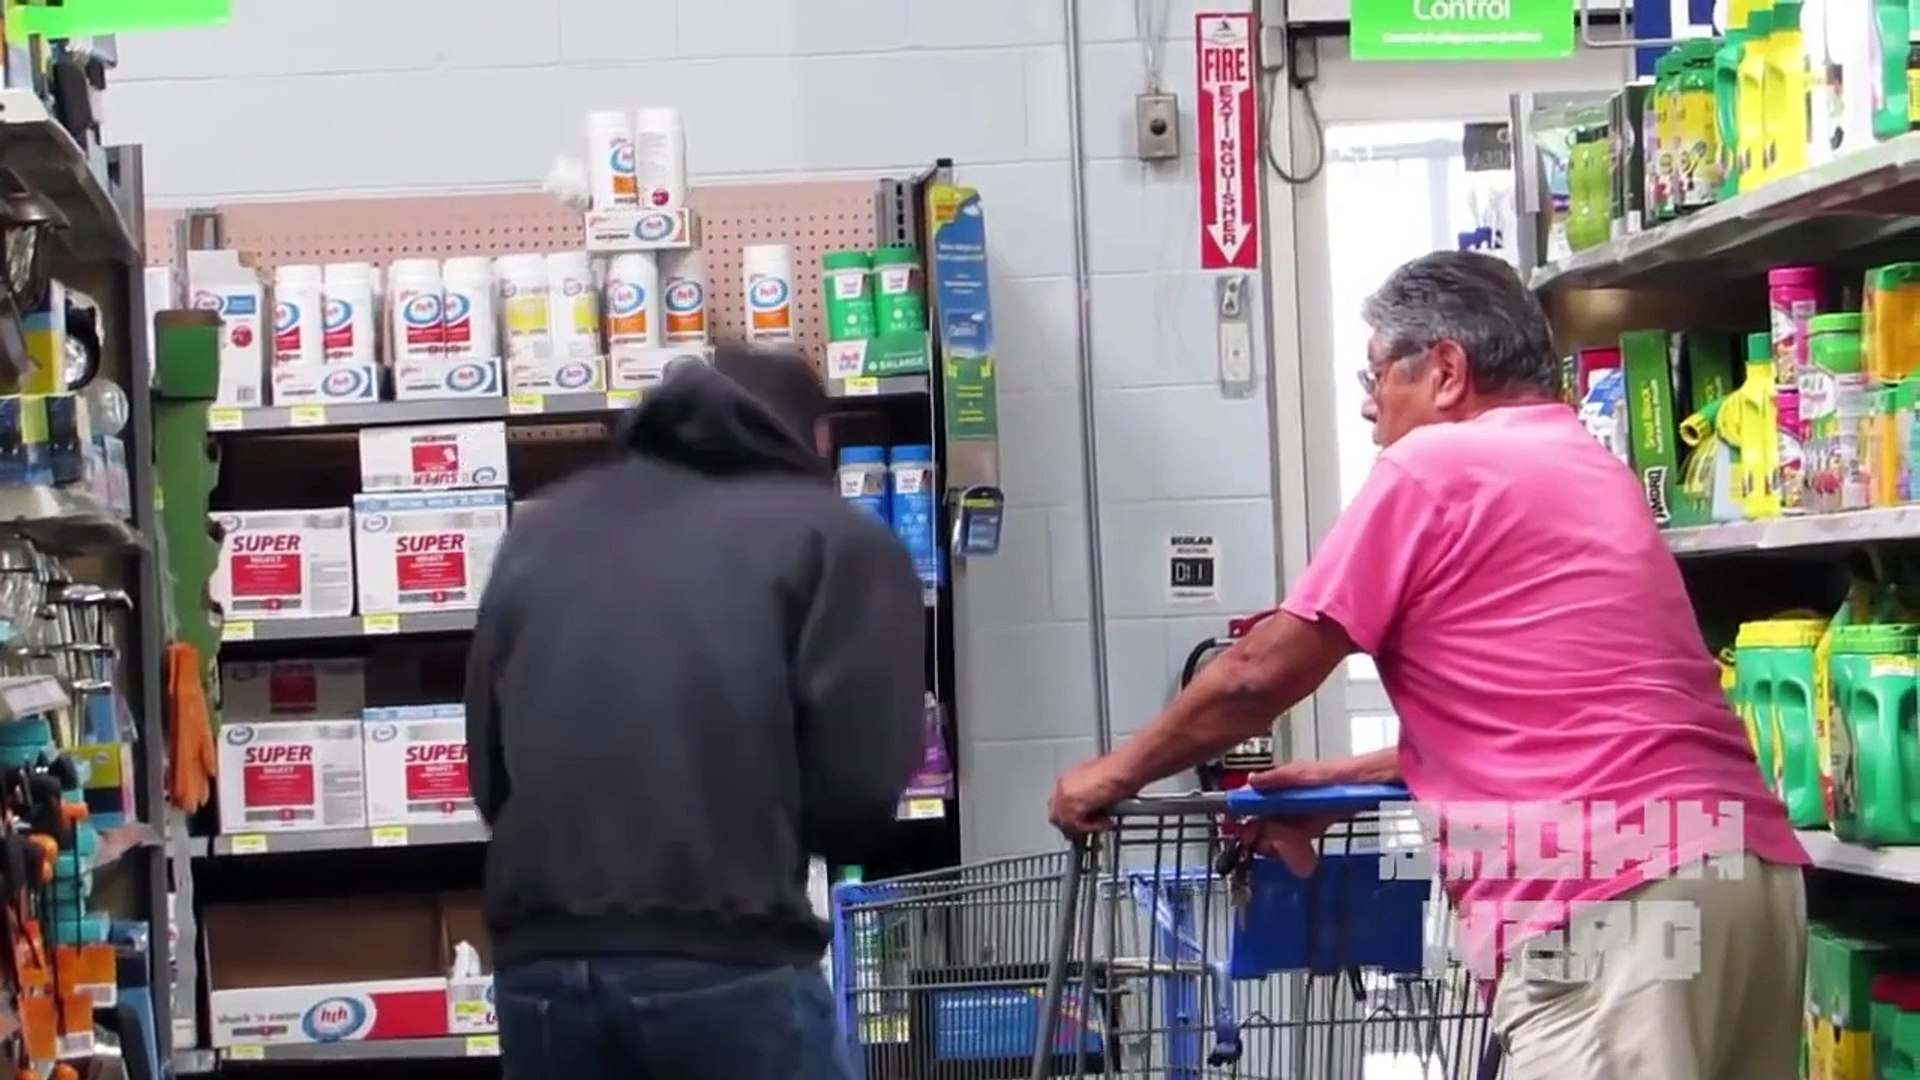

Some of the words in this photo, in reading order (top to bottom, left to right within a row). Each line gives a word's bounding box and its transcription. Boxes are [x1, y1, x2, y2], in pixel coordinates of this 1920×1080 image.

[1412, 0, 1511, 21] Control
[1204, 48, 1247, 82] FIRE
[1219, 85, 1237, 246] EXTINGUISHER
[232, 534, 301, 553] SUPER
[395, 534, 465, 553] SUPER
[244, 745, 313, 764] SUPER
[320, 1006, 348, 1023] hth
